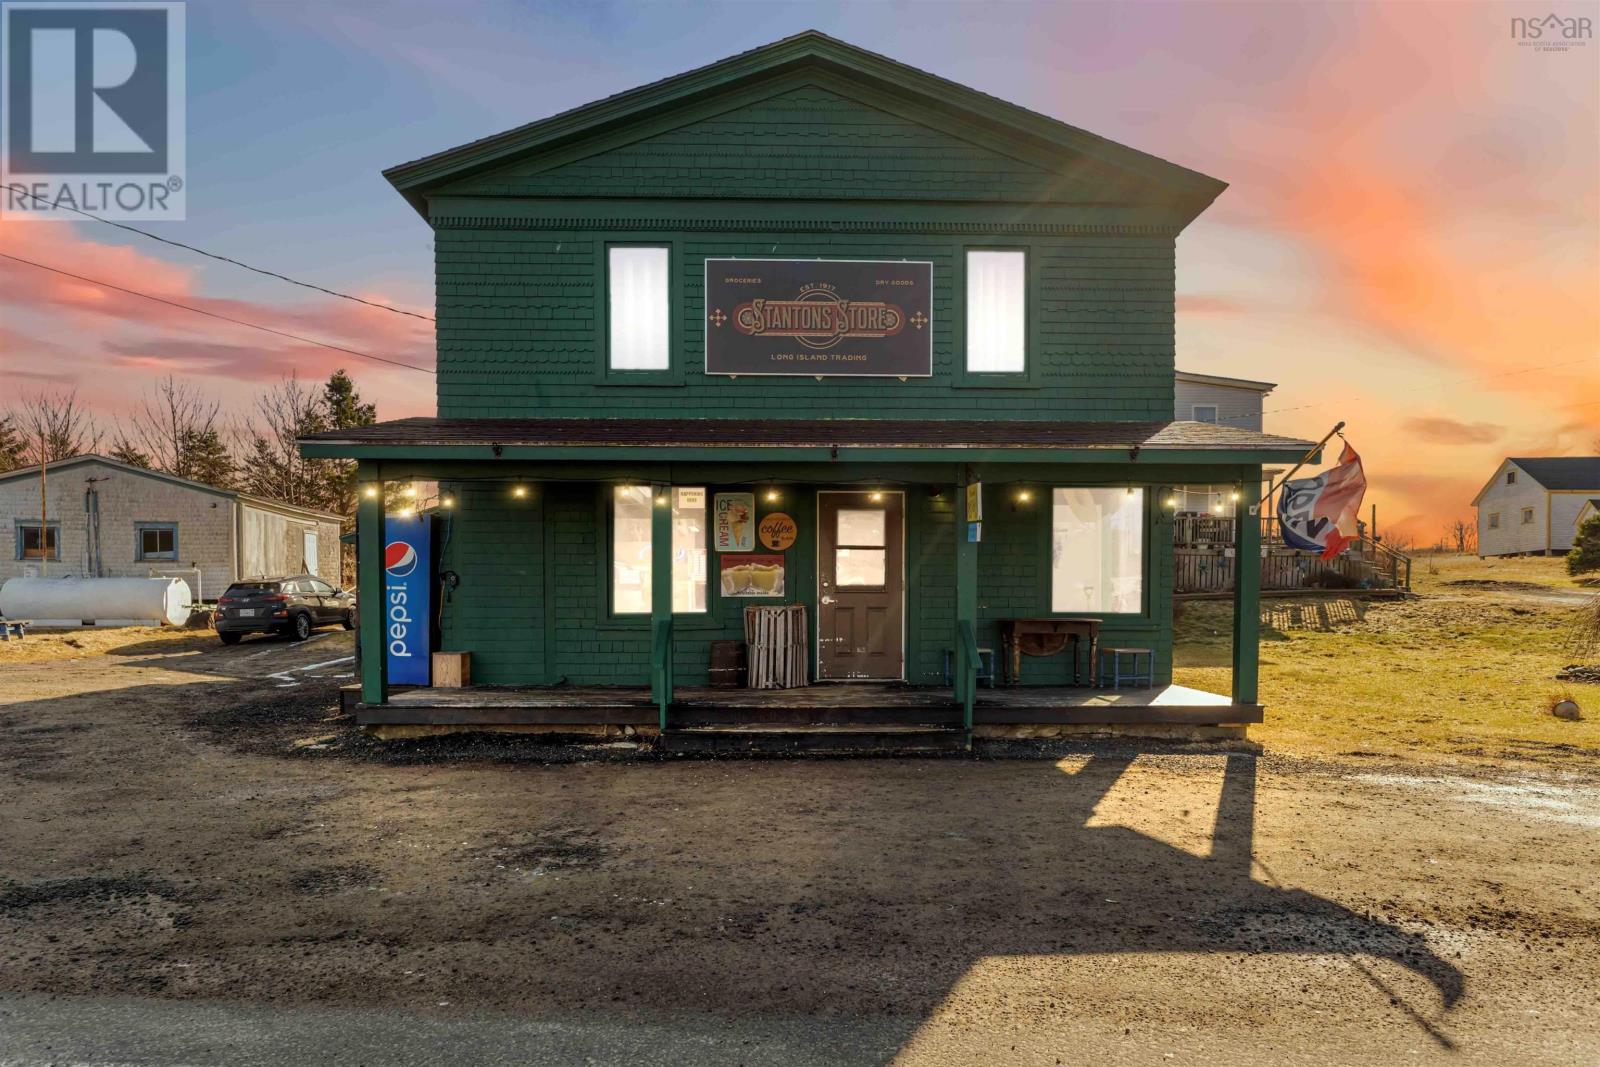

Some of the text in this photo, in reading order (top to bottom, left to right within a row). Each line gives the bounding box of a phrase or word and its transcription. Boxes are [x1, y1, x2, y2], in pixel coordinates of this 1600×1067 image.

[832, 299, 886, 335] STORE
[770, 353, 867, 362] LONG ISLAND TRADING
[719, 512, 729, 547] CREAM
[761, 521, 793, 538] coffee
